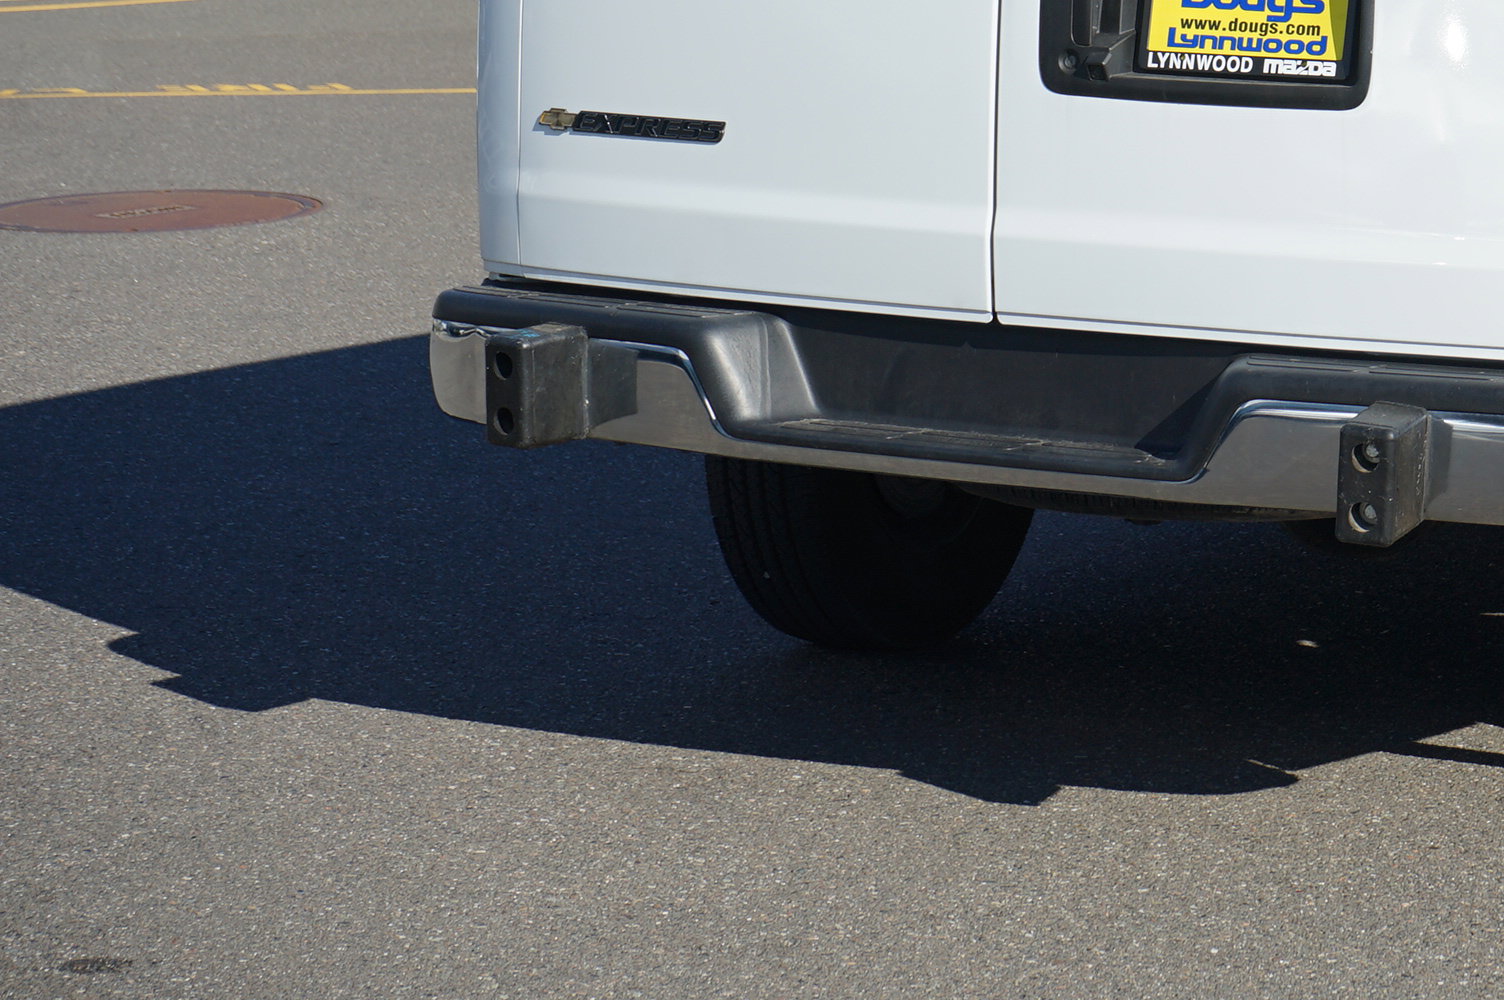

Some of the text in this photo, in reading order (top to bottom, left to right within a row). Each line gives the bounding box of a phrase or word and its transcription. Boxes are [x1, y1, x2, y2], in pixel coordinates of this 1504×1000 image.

[1180, 17, 1321, 36] www.dougs.com
[1167, 27, 1328, 56] Lynnwood
[1147, 51, 1337, 77] LYNNWOOD mazda
[573, 110, 726, 143] EXPRESS
